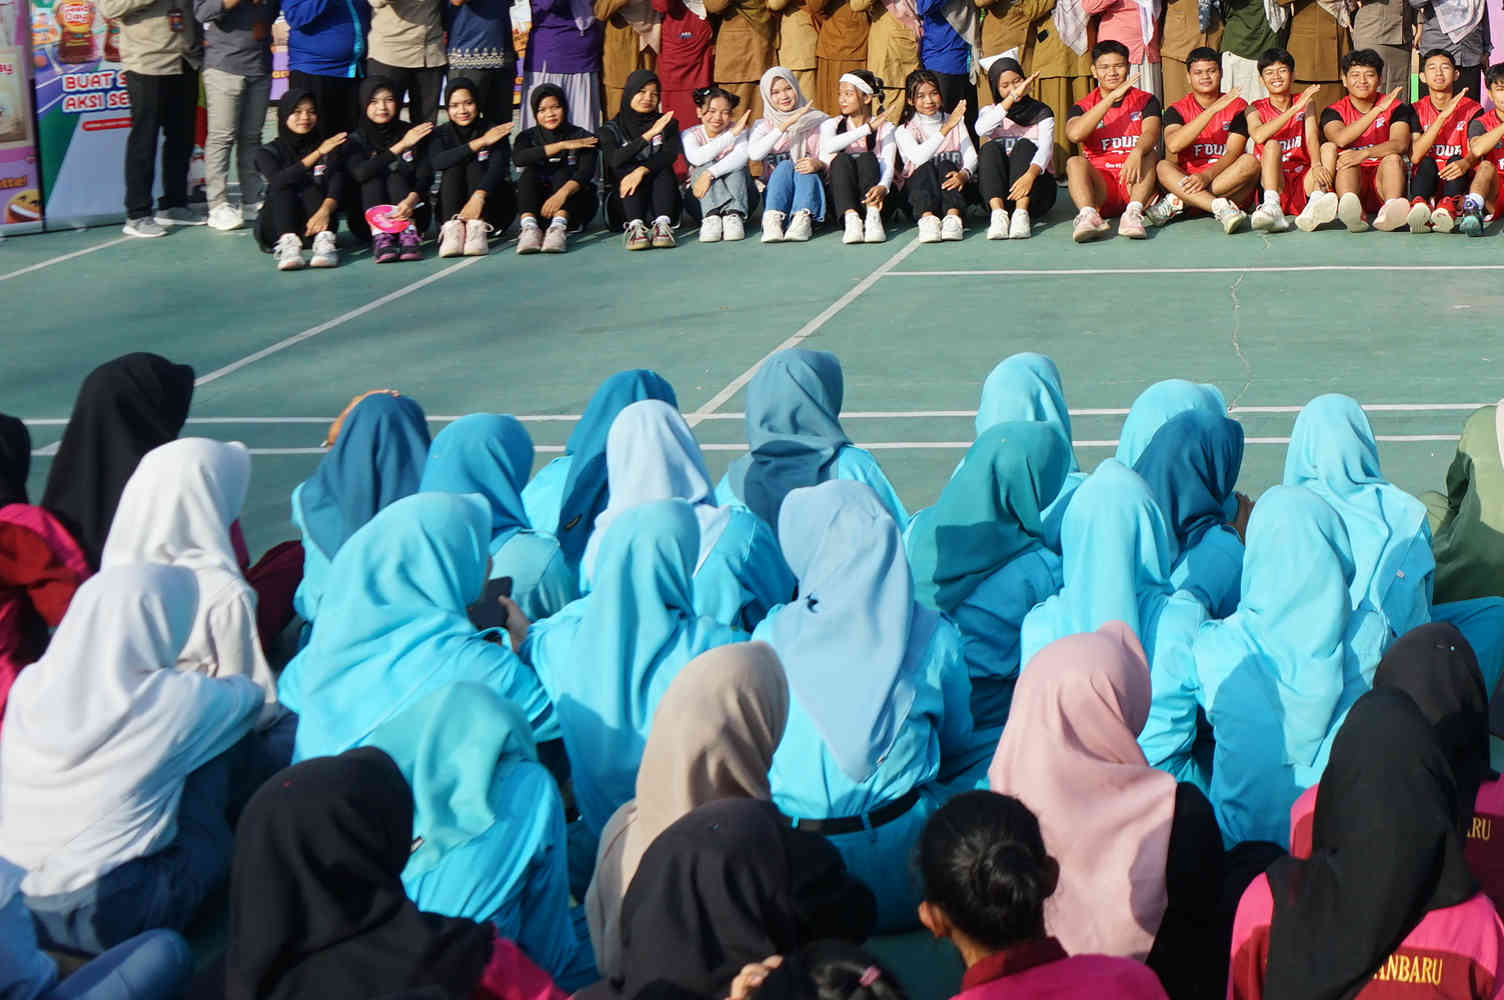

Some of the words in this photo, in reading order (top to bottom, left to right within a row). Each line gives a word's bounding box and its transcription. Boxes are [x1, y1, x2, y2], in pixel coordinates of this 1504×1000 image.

[65, 73, 115, 90] BUAT
[65, 95, 105, 110] AKSI
[1194, 143, 1227, 157] FOU
